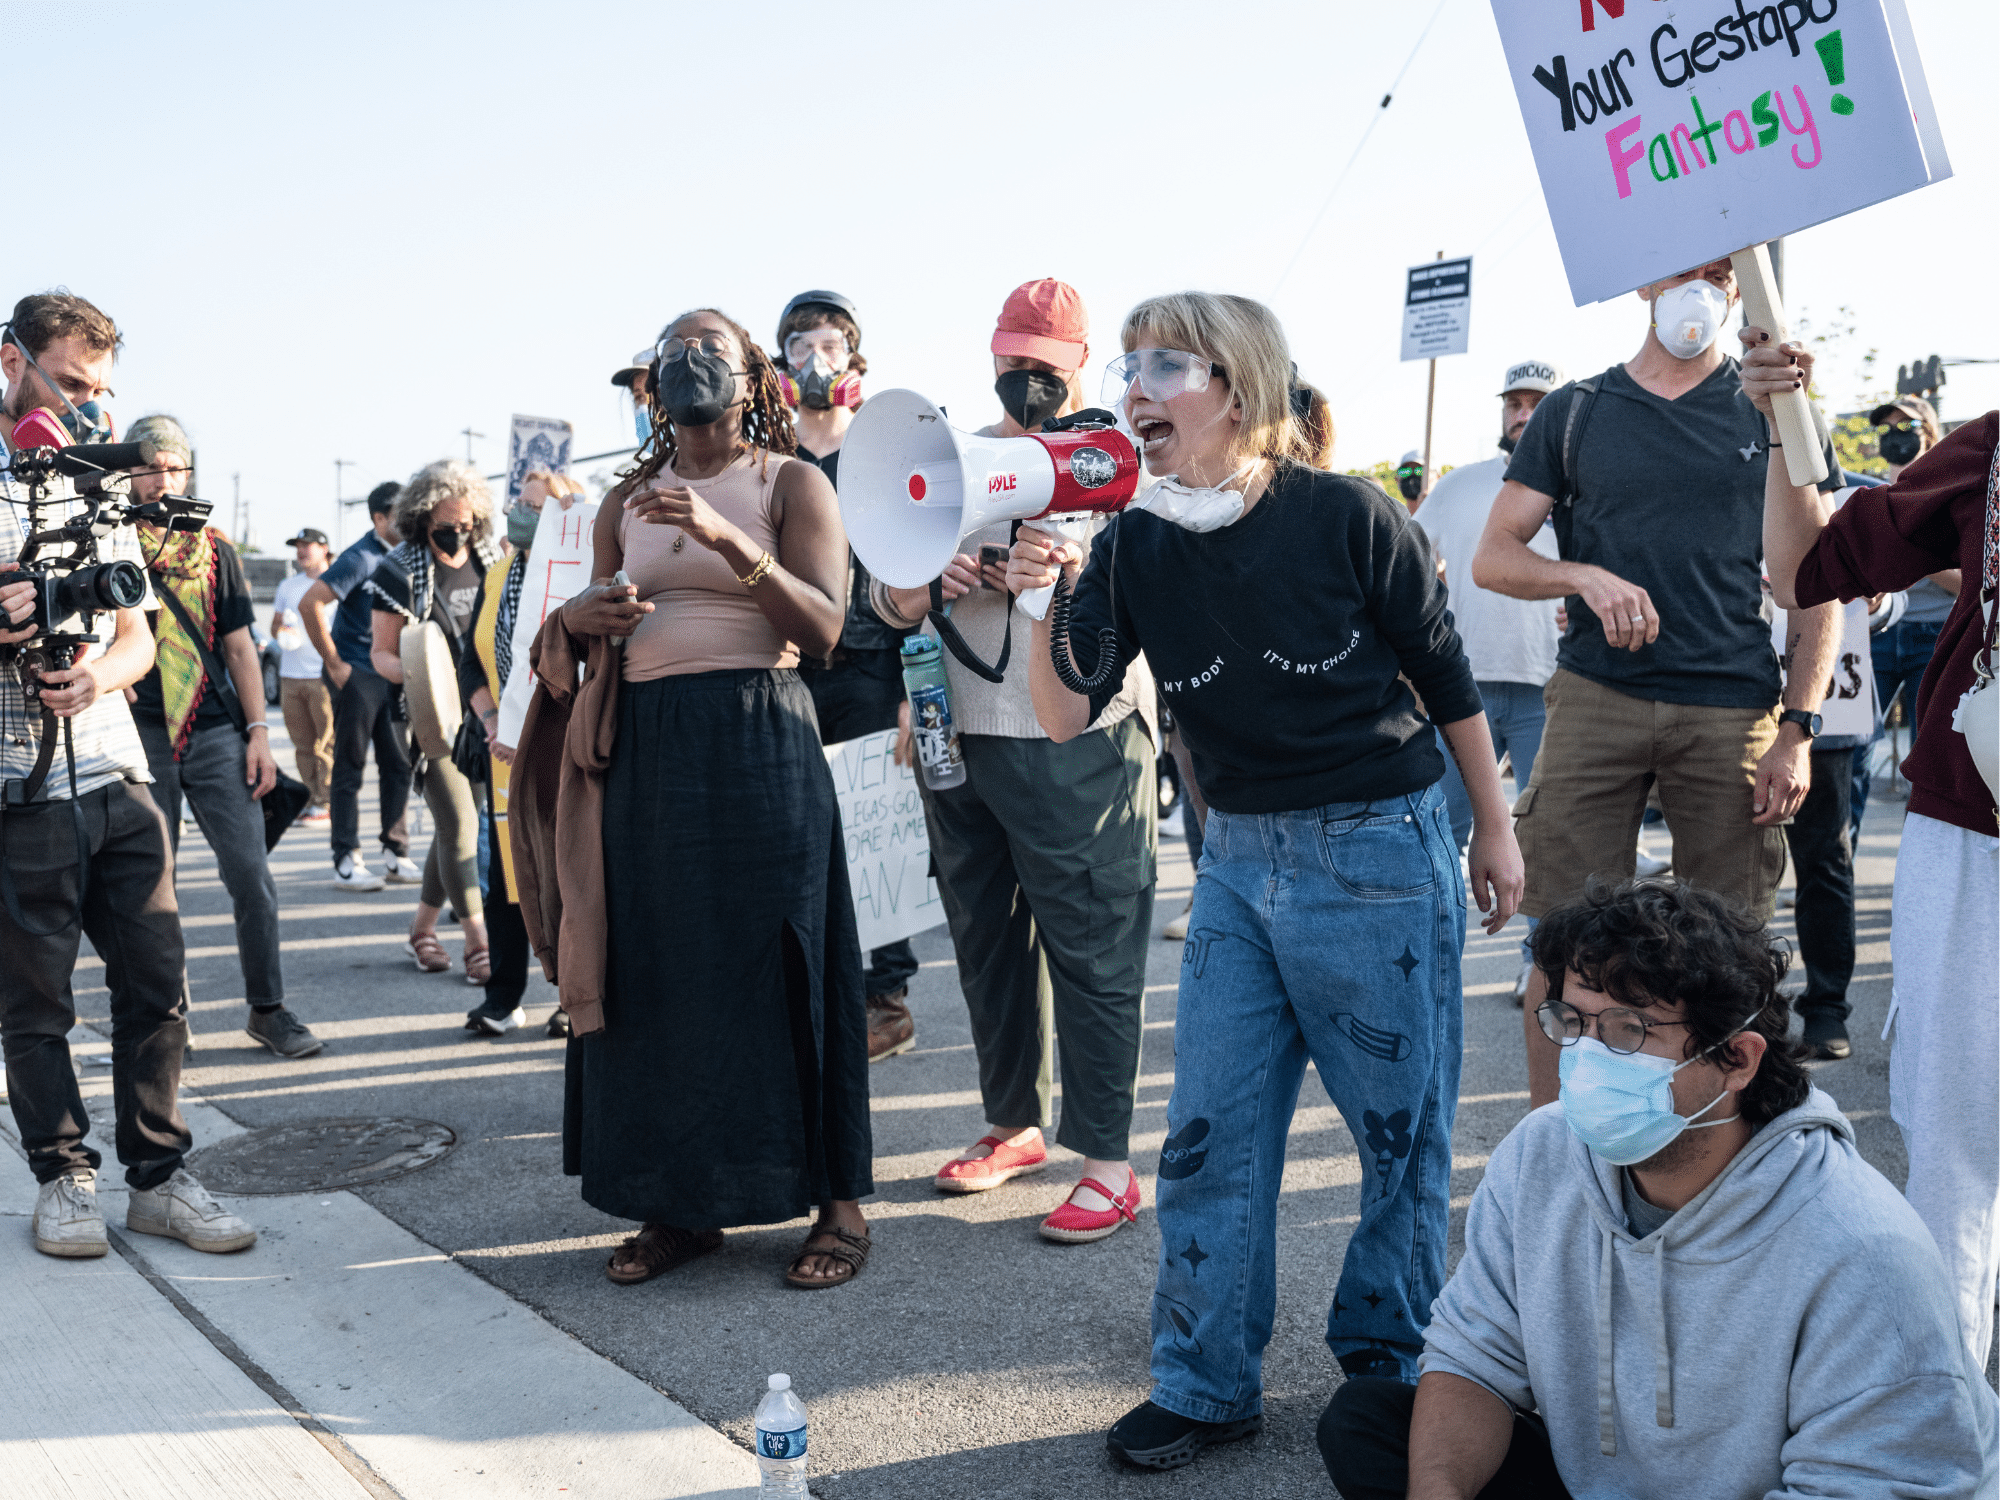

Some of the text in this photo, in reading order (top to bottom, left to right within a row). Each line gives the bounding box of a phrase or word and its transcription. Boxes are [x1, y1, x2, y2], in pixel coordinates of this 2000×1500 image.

[1532, 0, 1838, 131] Your Gestapo
[1508, 364, 1556, 385] CHICAGO
[1263, 629, 1360, 674] IT'S MY CHOICE
[1164, 656, 1225, 692] MY BODY
[766, 1432, 786, 1442] Pure
[768, 1440, 784, 1451] Life
